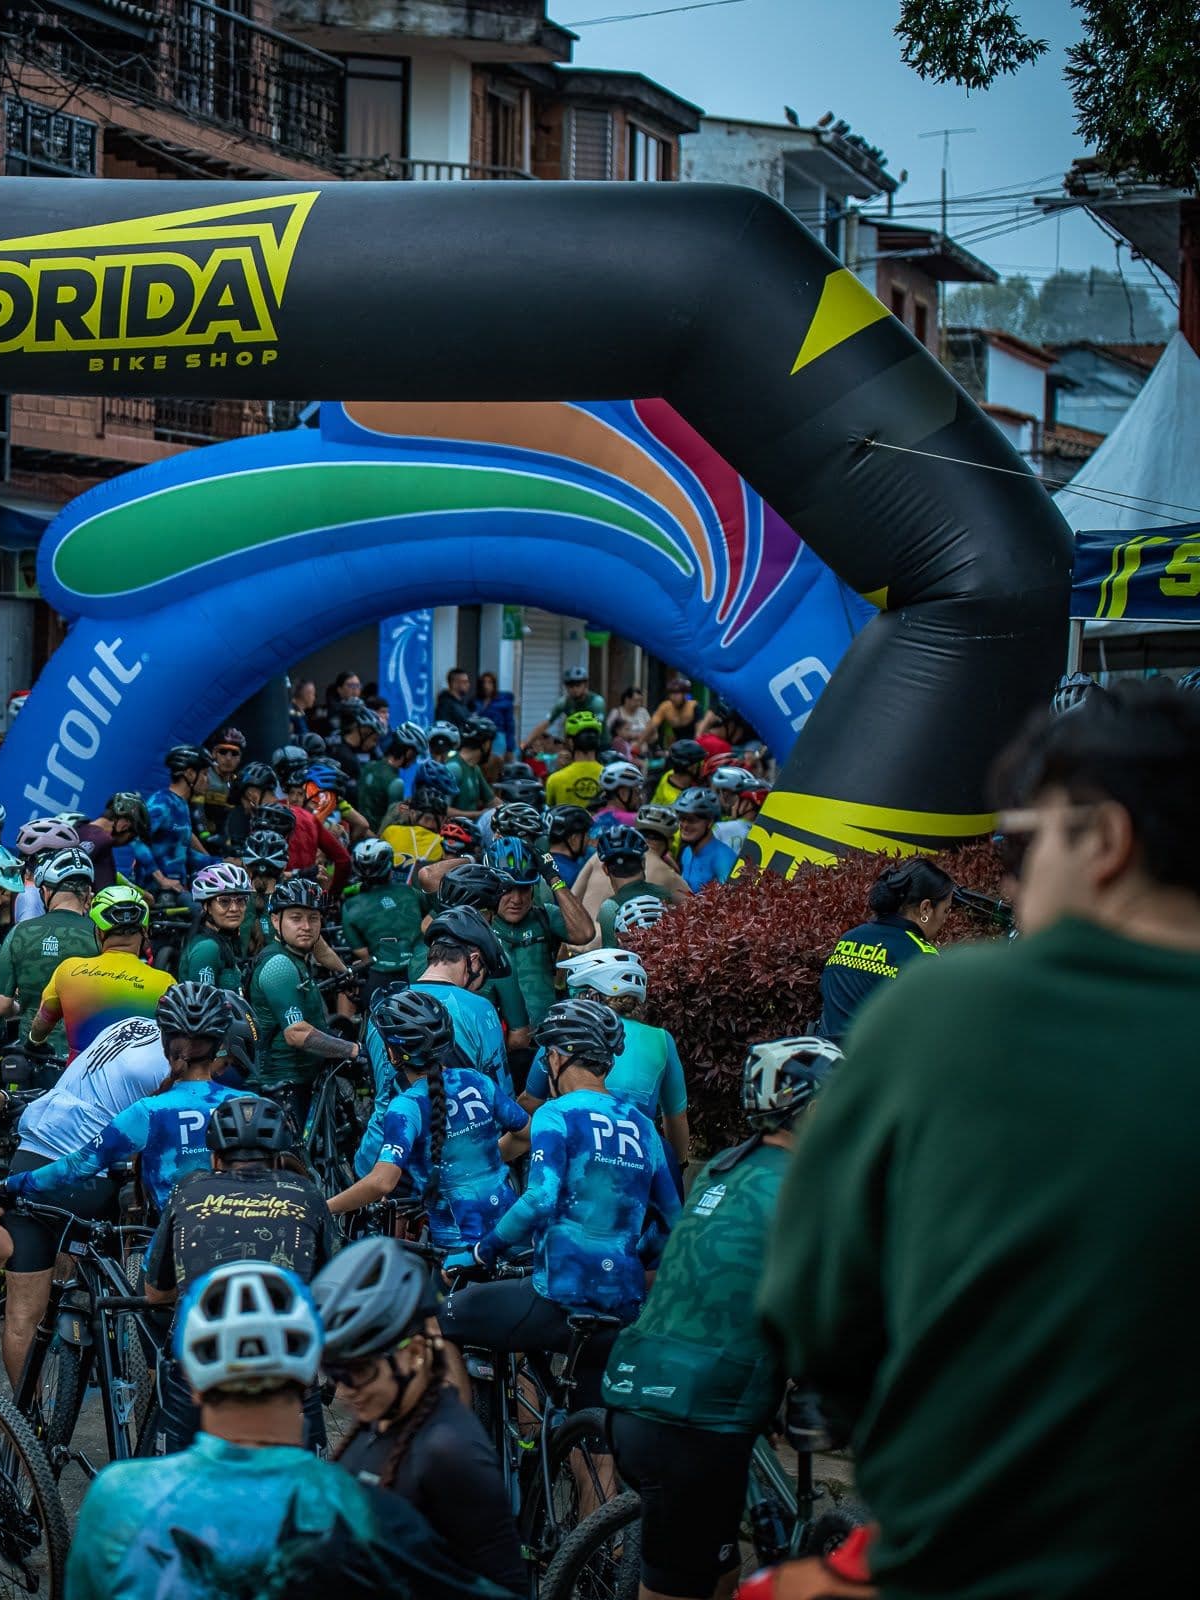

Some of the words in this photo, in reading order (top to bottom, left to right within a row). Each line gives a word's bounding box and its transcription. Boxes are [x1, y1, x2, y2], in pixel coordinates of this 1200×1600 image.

[89, 355, 168, 372] BIKE
[186, 350, 279, 369] SHOP
[41, 942, 59, 952] TOUR
[834, 940, 887, 963] POLICÍA
[70, 963, 144, 983] Colombia
[178, 1109, 212, 1145] P
[589, 1112, 644, 1158] PR
[380, 1143, 404, 1159] PR
[594, 1152, 616, 1165] Record
[616, 1156, 645, 1170] Personal
[203, 1194, 291, 1210] Manizales
[234, 1208, 280, 1218] alma!!
